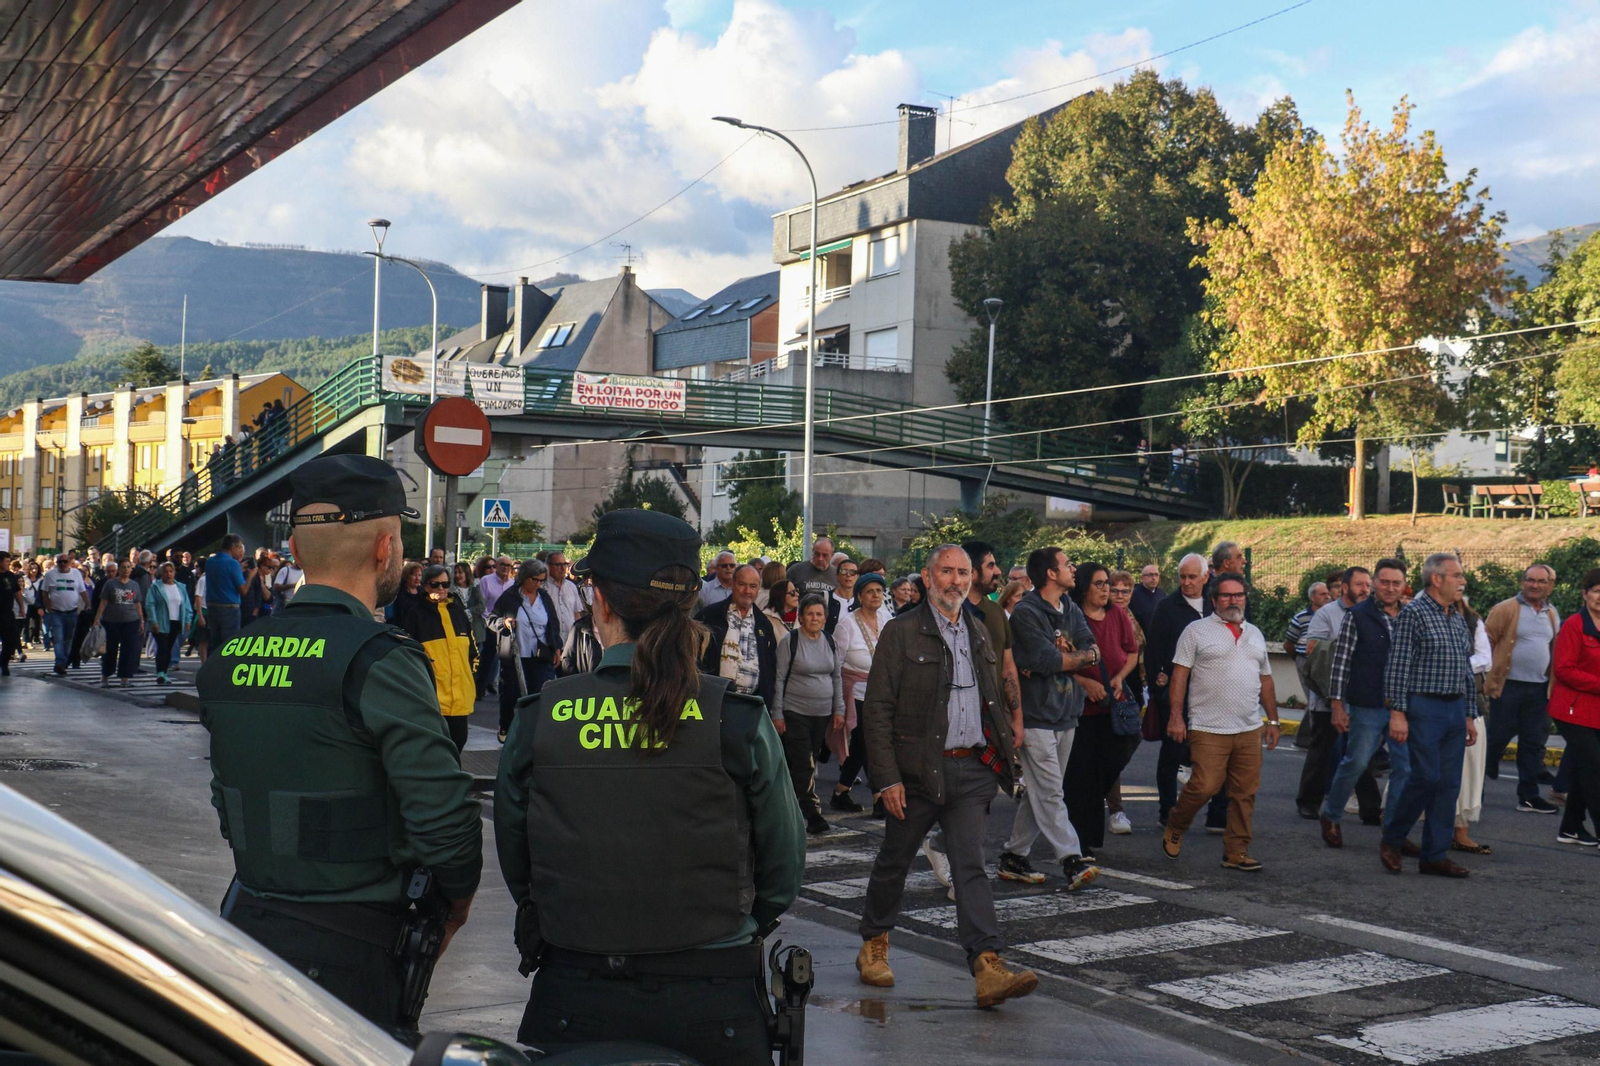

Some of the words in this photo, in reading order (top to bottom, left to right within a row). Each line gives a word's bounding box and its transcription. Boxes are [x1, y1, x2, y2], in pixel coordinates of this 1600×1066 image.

[470, 368, 521, 379] QUEREMOS
[486, 382, 501, 392] UN
[577, 384, 593, 395] EN
[597, 386, 632, 397] LOITA
[635, 388, 661, 399] POR
[664, 390, 682, 400] UN
[477, 399, 523, 410] EUMOLOGO
[578, 395, 645, 408] CONVENIO
[648, 399, 679, 410] DIGO
[221, 636, 326, 658] GUARDIA
[231, 663, 293, 688] CIVIL
[551, 696, 704, 722] GUARA
